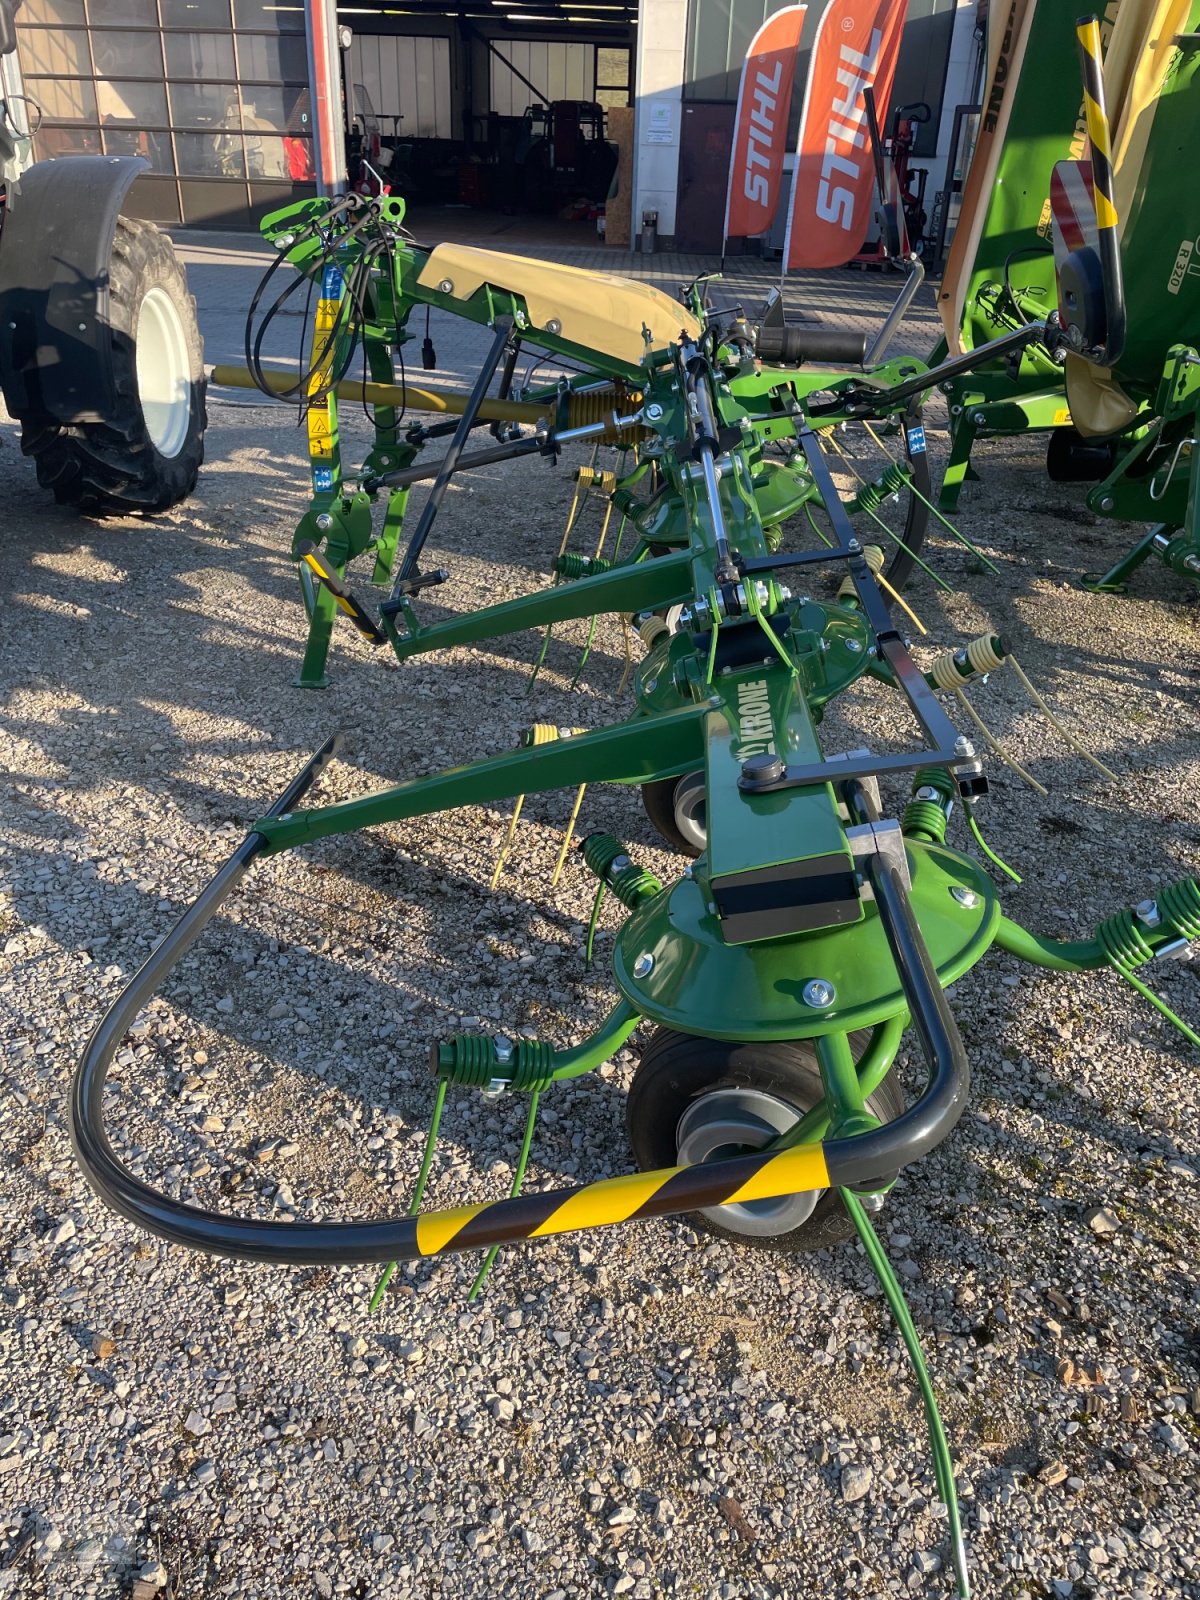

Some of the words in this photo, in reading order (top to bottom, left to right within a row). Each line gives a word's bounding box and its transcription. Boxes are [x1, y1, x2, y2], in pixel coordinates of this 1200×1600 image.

[744, 61, 782, 208] STIHL
[815, 28, 882, 231] STIHL
[1170, 261, 1186, 287] 320
[1180, 249, 1190, 258] R
[738, 680, 773, 742] KRONE
